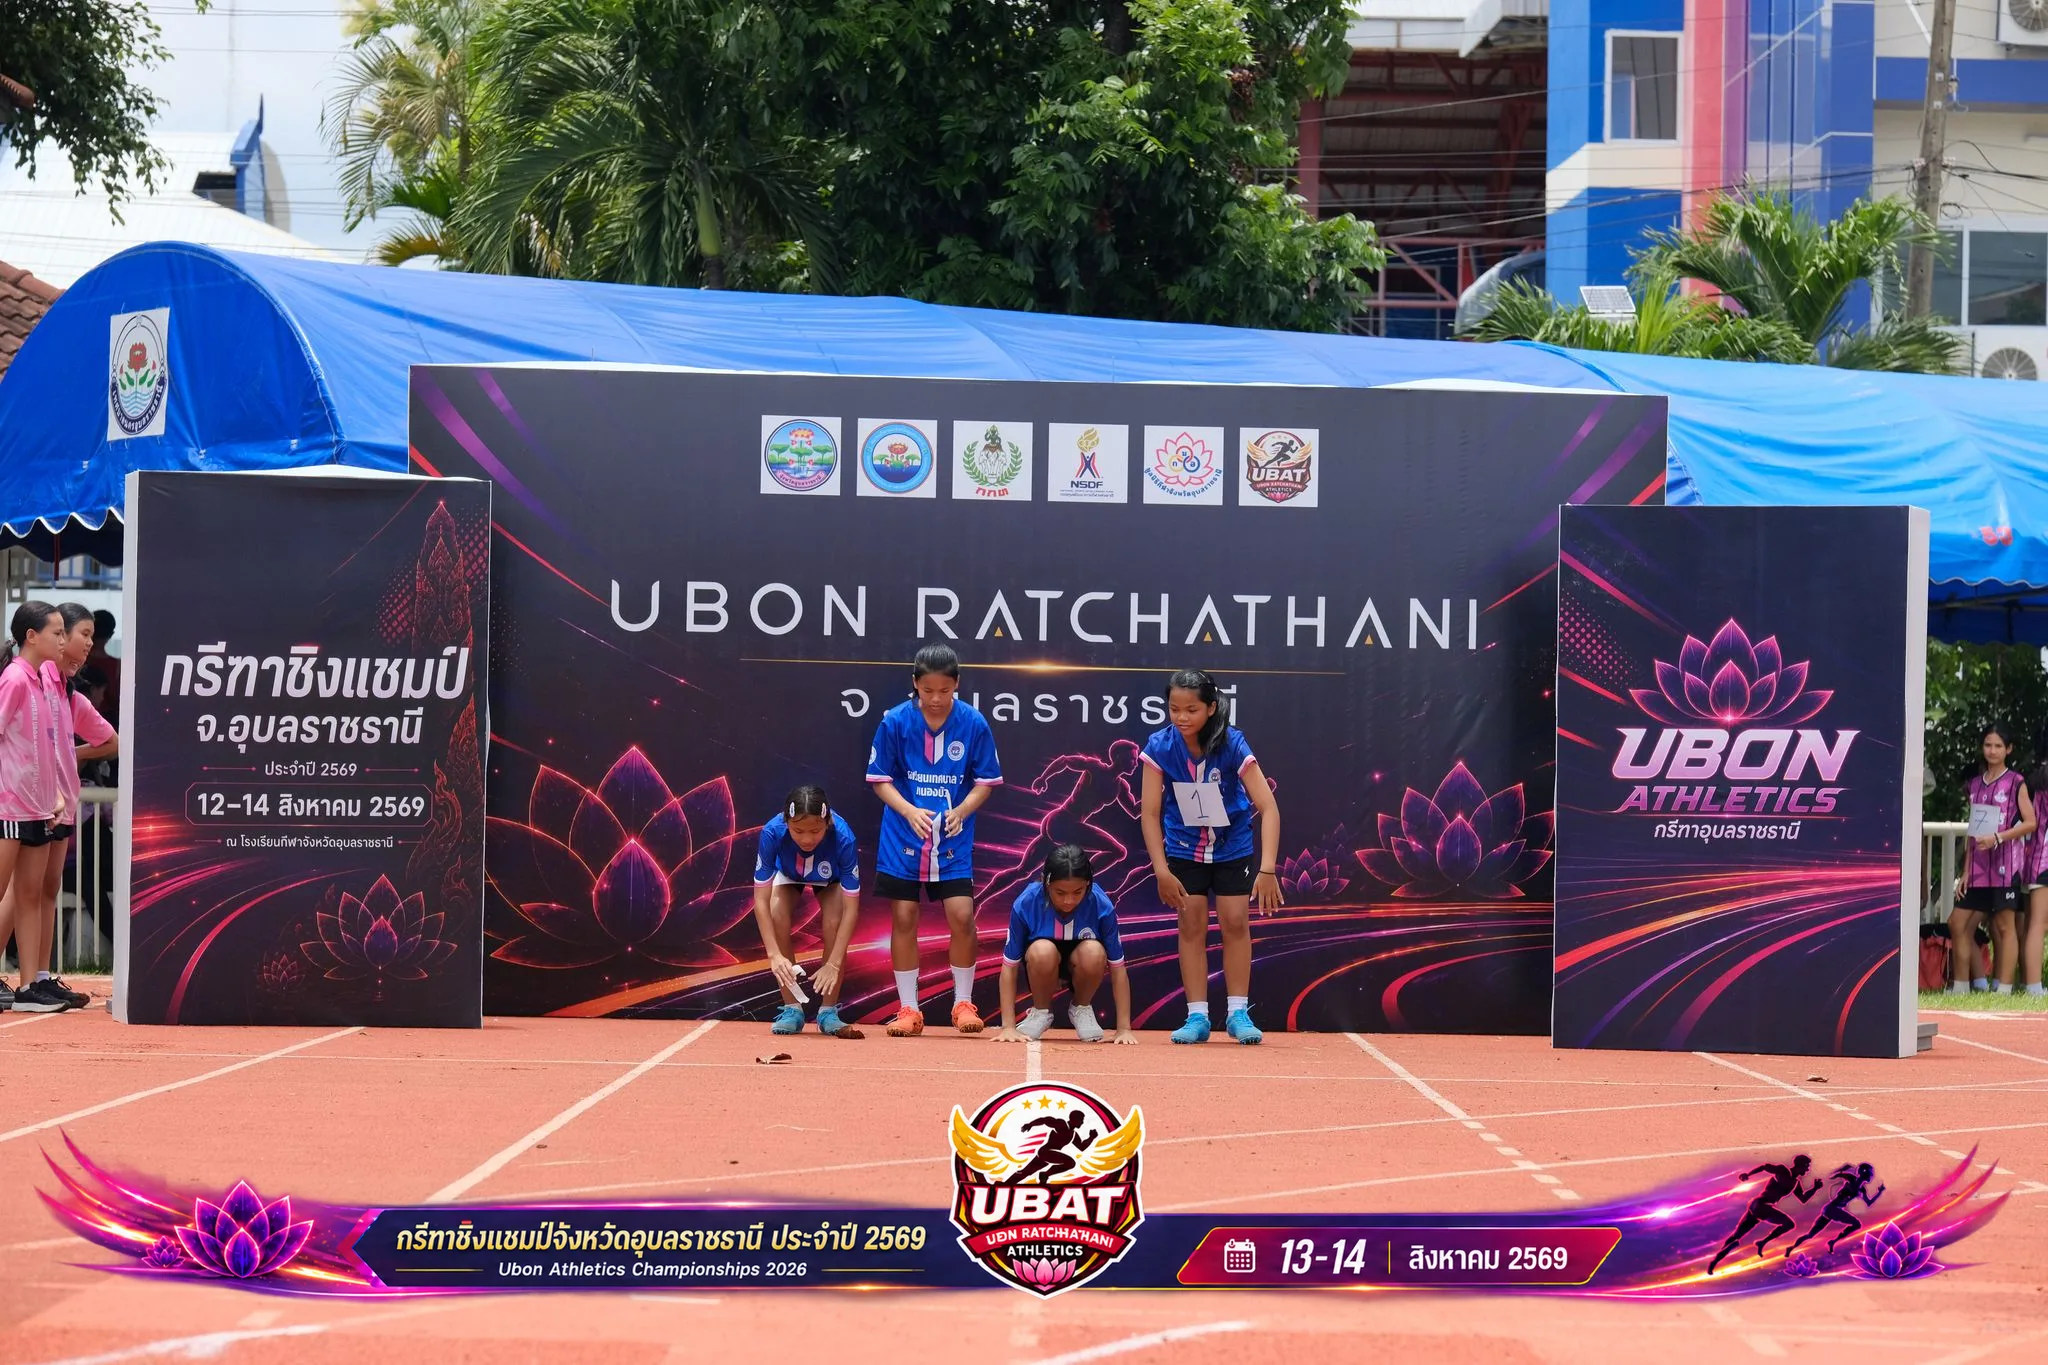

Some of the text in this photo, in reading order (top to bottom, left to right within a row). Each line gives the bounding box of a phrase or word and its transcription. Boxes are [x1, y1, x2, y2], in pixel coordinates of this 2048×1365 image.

[1070, 480, 1104, 489] NSDF
[1252, 467, 1306, 482] UBAT
[610, 578, 1478, 650] UBON RATCHATHANI
[160, 640, 470, 700] กรีฑาชิงแชมป์
[196, 706, 424, 754] จ.อุบลราชธานี
[1611, 727, 1861, 782] UBON
[264, 759, 358, 777] ประจำปี 2569
[278, 792, 361, 817] สิงหาคม
[369, 795, 425, 818] 2569
[1191, 789, 1209, 819] 1
[1612, 785, 1849, 814] ATHLETICS
[1653, 819, 1801, 844] กรีฑาอุบลราชธานี
[1975, 809, 1988, 831] 7
[226, 834, 394, 851] ณ โรงเรียนกีฬาจังหวัดอุบลราชธานี
